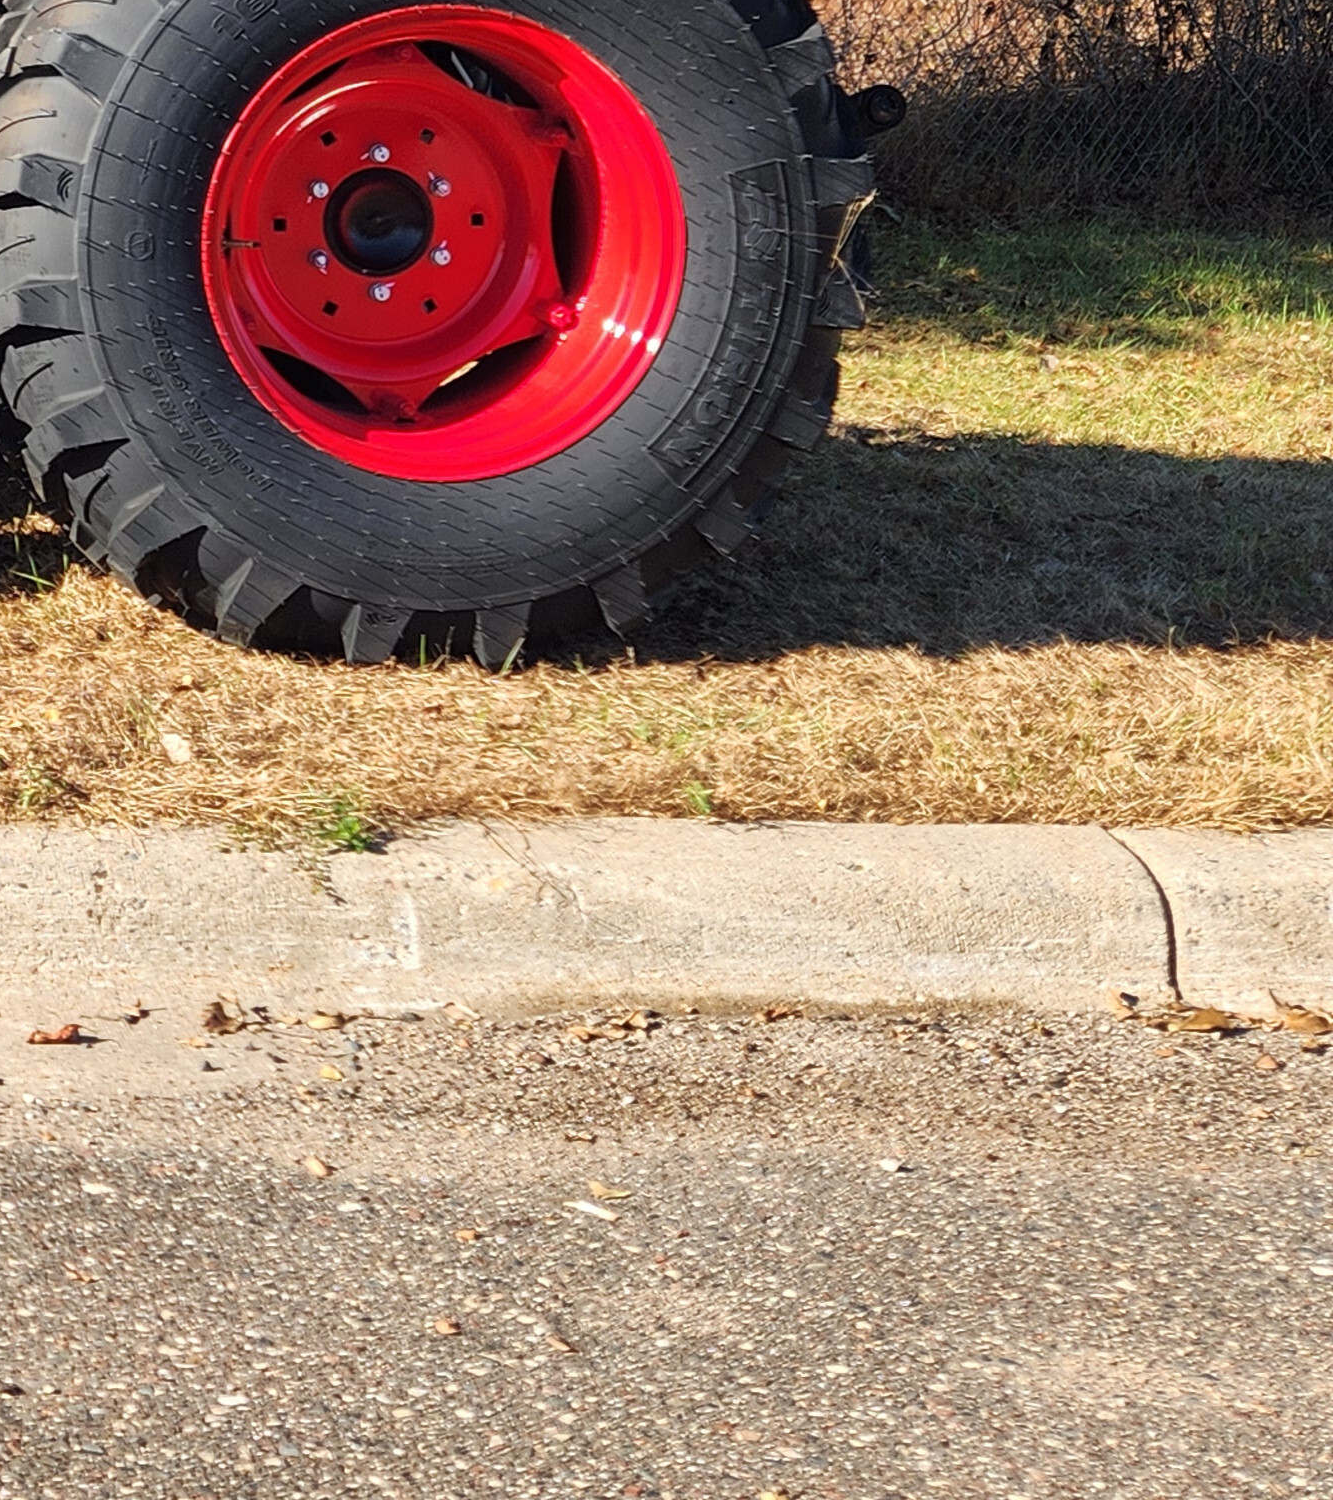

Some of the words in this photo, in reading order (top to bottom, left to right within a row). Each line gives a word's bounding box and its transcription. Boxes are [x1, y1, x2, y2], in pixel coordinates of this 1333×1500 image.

[146, 313, 190, 393] GRIP
[664, 283, 780, 468] TIRON
[141, 364, 224, 476] HYBRID
[182, 397, 274, 492] POWER
